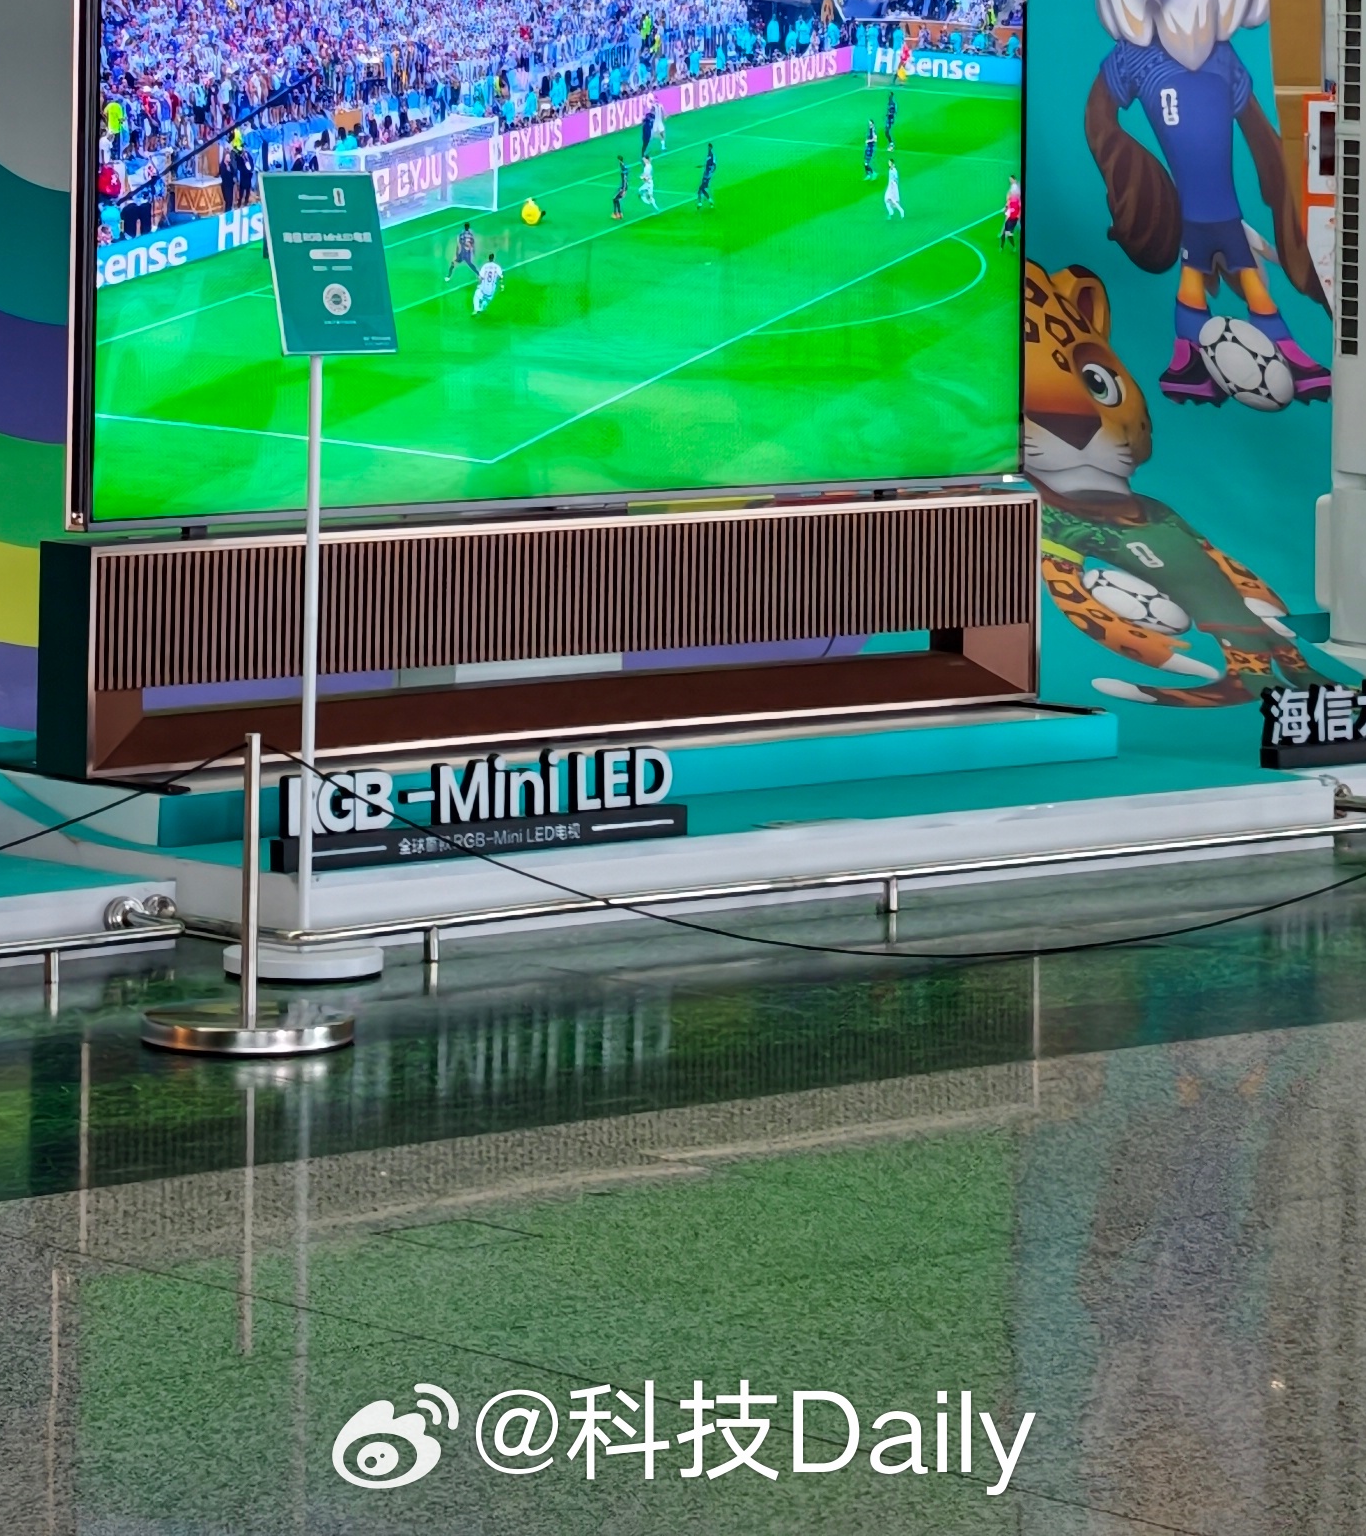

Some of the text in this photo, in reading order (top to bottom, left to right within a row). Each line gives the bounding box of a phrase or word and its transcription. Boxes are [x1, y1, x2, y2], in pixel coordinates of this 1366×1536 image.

[699, 70, 748, 108] BYJU'S
[510, 118, 563, 162] BYJU'S
[573, 749, 673, 812] LED
